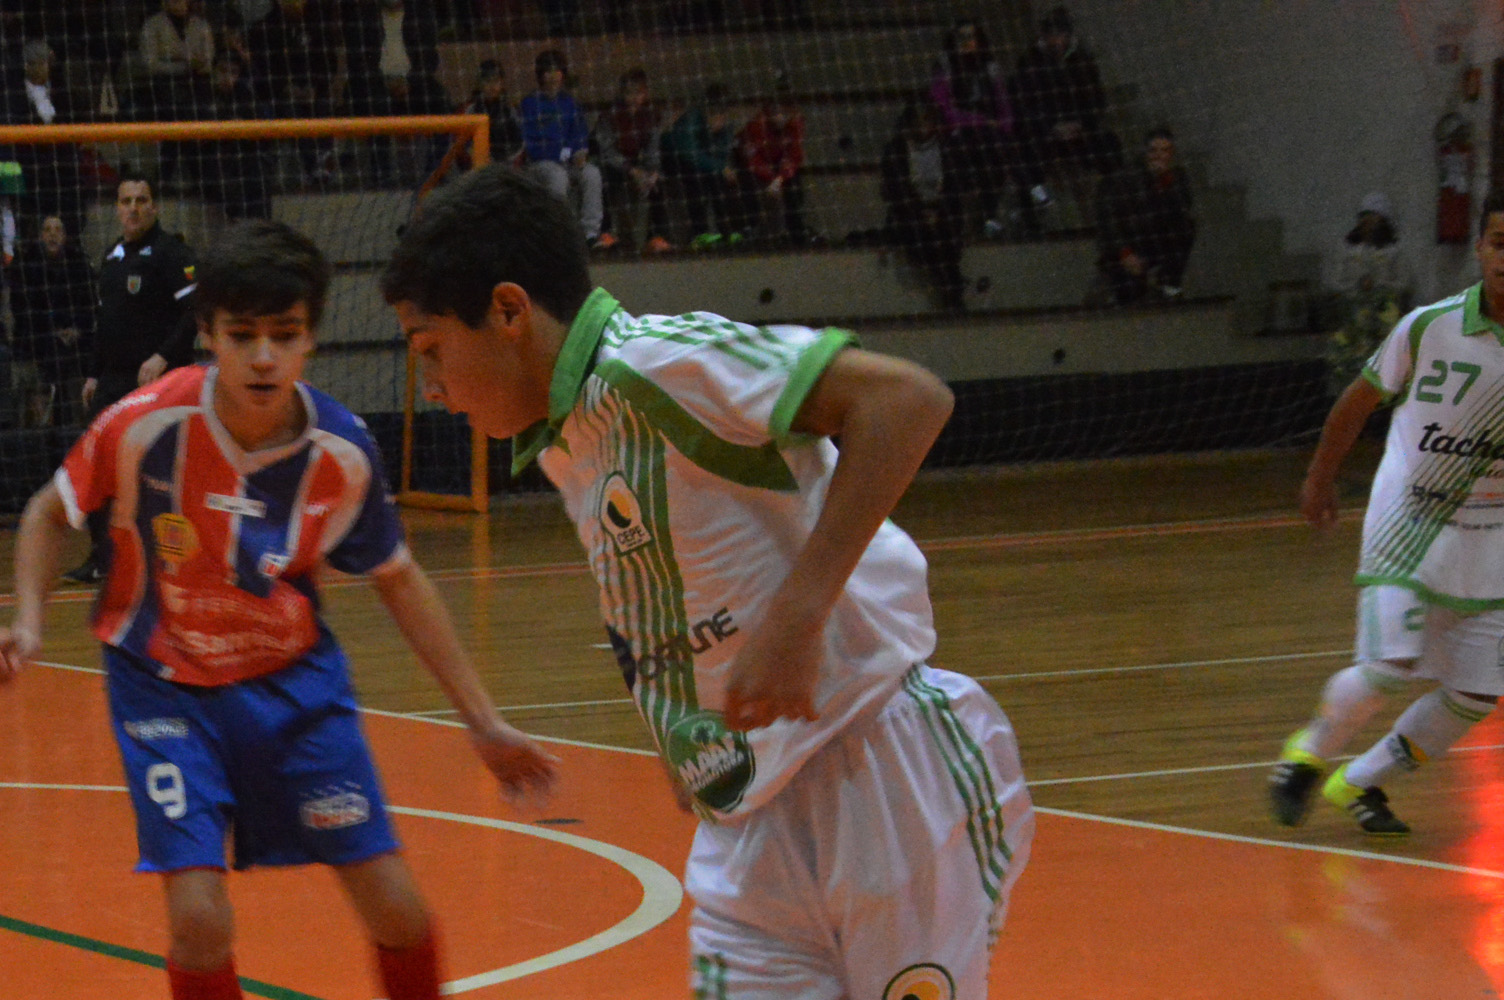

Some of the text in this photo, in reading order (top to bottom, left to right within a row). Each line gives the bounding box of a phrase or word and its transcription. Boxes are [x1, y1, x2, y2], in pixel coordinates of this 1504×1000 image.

[1416, 359, 1482, 406] 27
[616, 525, 645, 546] CEPE
[145, 762, 188, 820] 9
